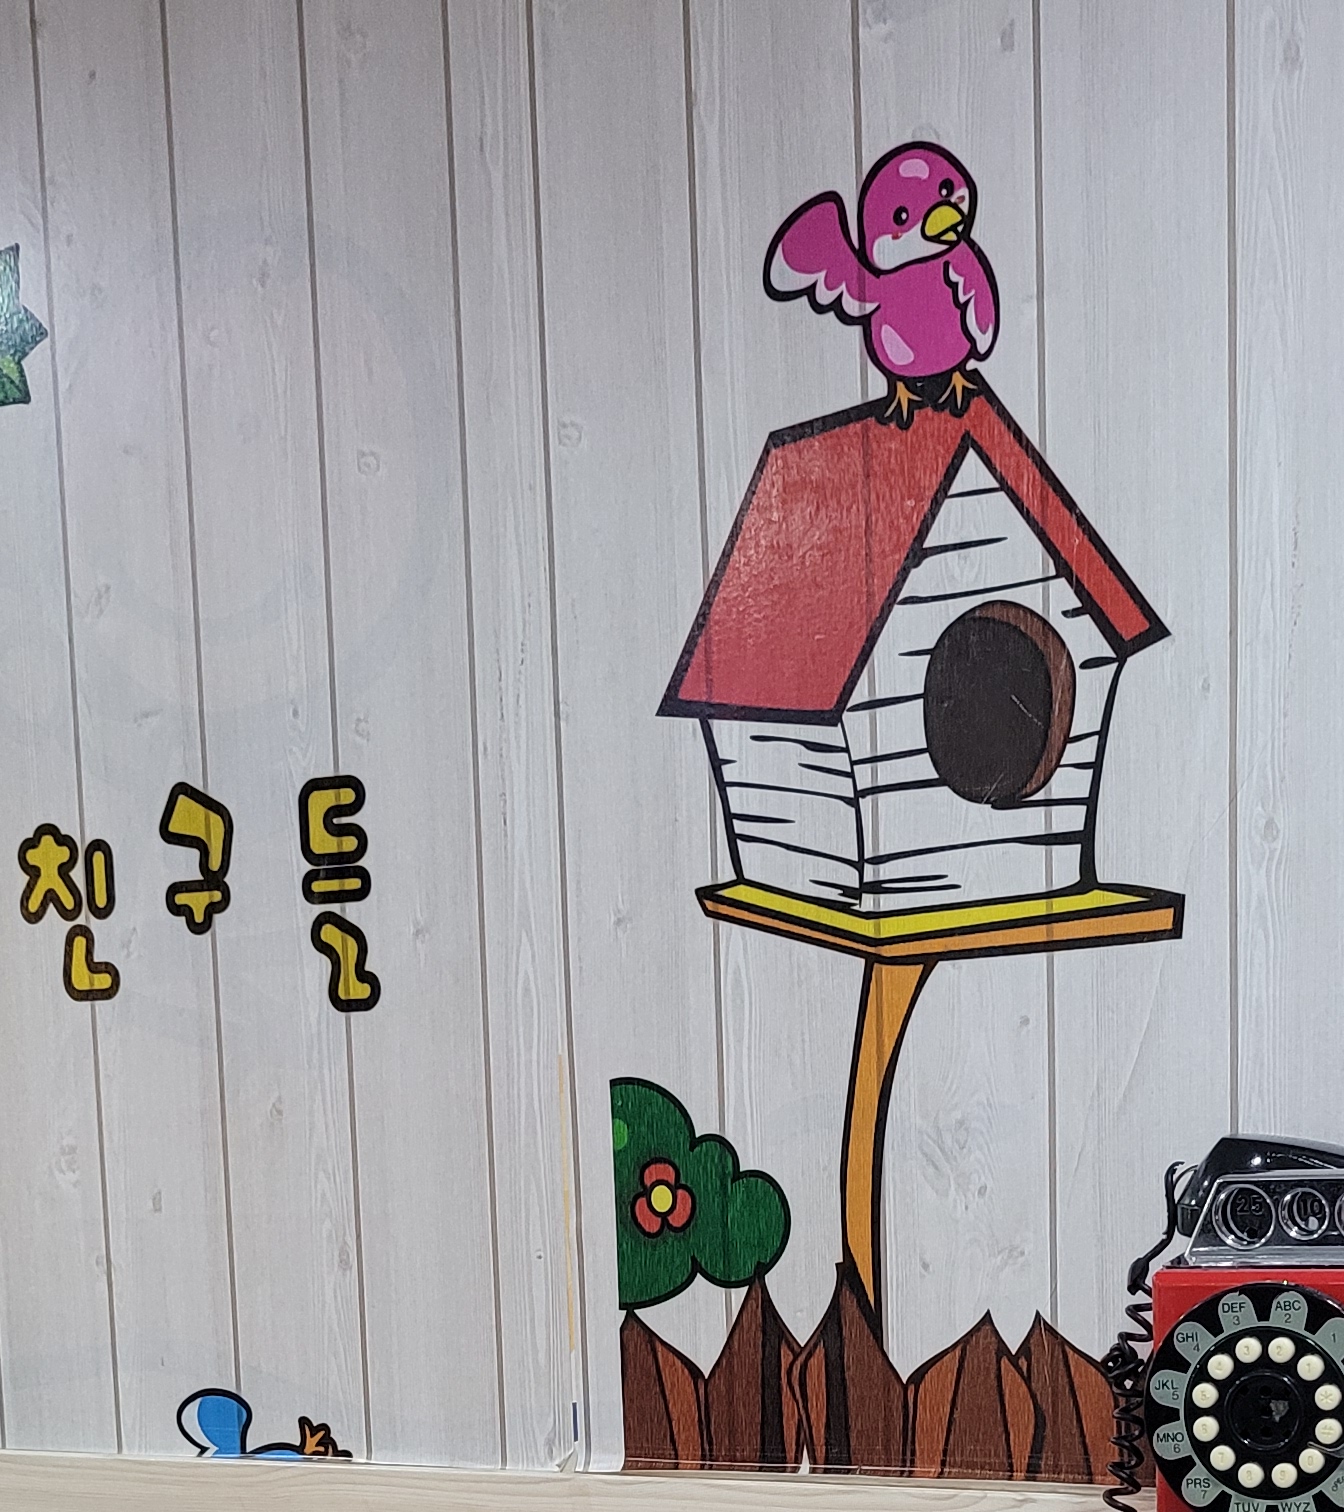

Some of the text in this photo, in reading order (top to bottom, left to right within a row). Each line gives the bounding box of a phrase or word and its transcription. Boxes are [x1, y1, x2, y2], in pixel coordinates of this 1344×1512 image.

[17, 775, 381, 1012] 친구들
[1236, 1194, 1264, 1216] 25
[1221, 1301, 1246, 1314] DEF
[1274, 1299, 1302, 1312] ABC
[1232, 1315, 1241, 1326] 3
[1284, 1313, 1293, 1324] 2
[1175, 1331, 1199, 1344] GHI
[1331, 1332, 1337, 1343] 1
[1192, 1342, 1201, 1353] 4
[1243, 1345, 1251, 1356] 3
[1276, 1345, 1283, 1357] 2
[1306, 1362, 1312, 1374] 1
[1154, 1379, 1179, 1391] JKL
[1171, 1390, 1180, 1401] 5
[1156, 1431, 1185, 1443] MNO
[1173, 1443, 1182, 1454] 6
[1218, 1452, 1226, 1464] 7
[1185, 1477, 1212, 1490] PRS
[1200, 1489, 1208, 1500] 7
